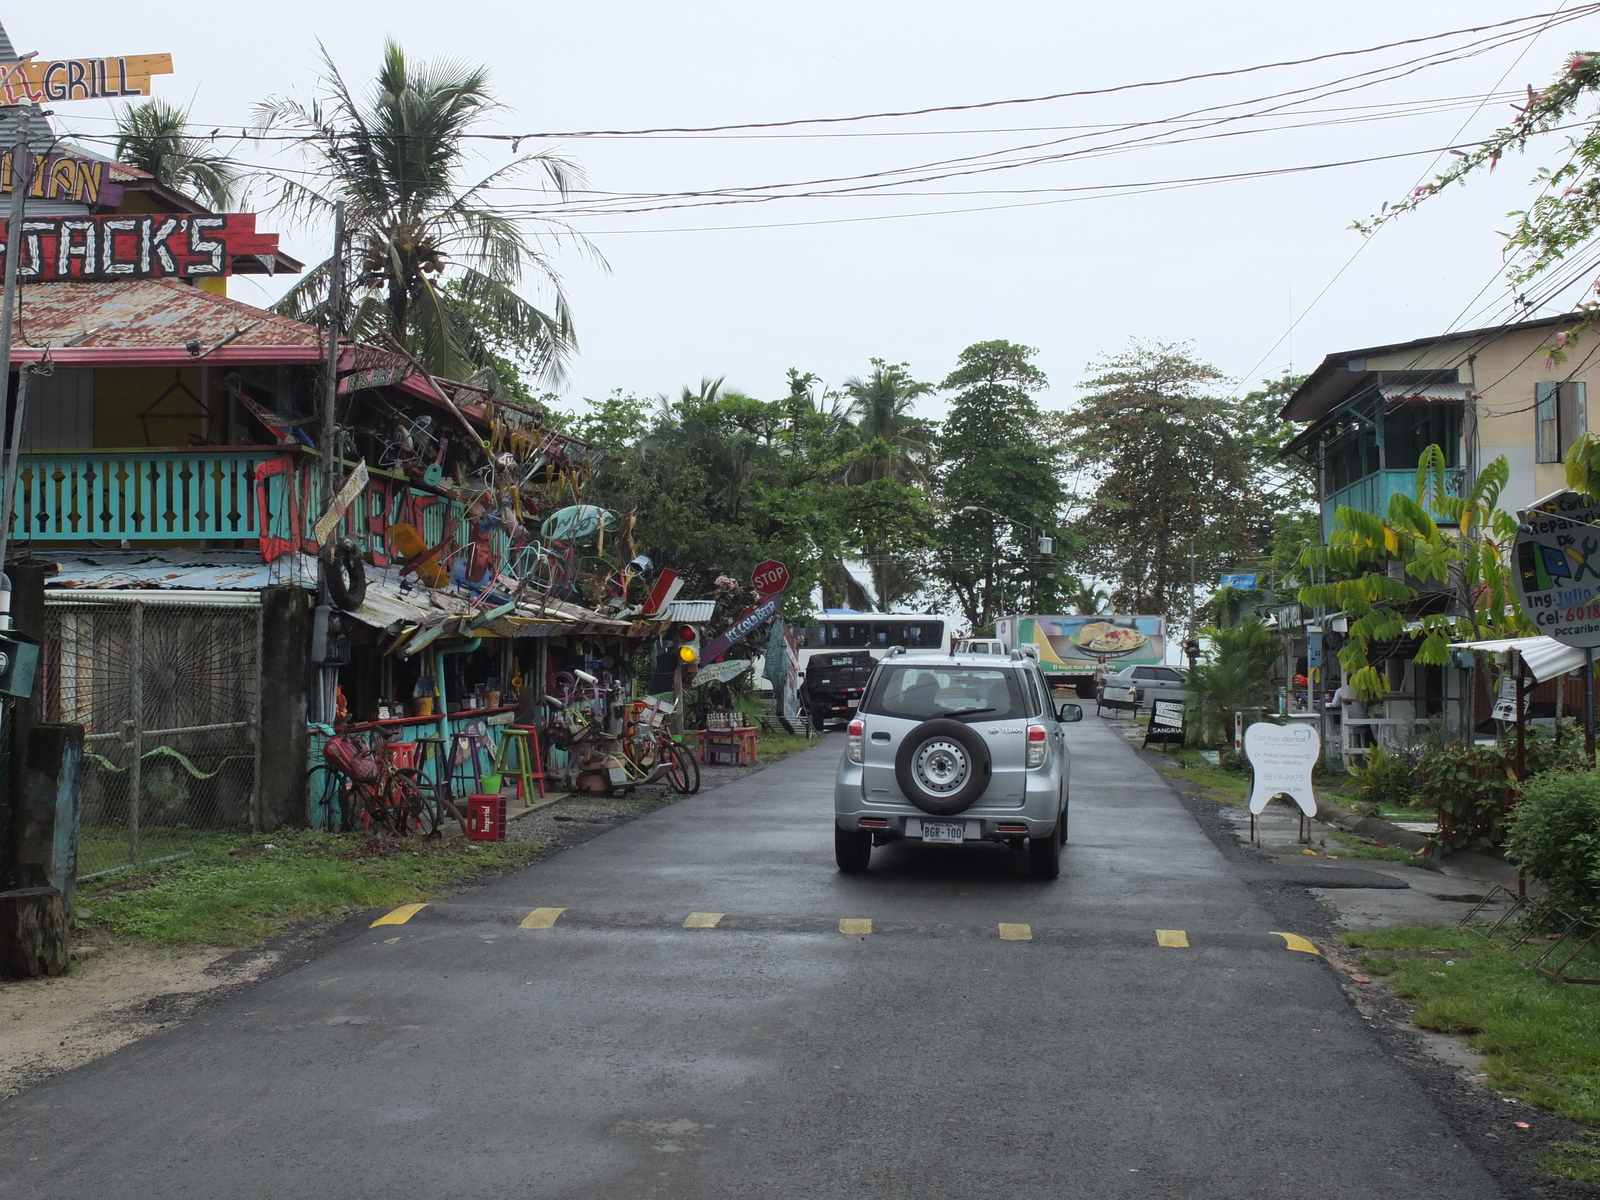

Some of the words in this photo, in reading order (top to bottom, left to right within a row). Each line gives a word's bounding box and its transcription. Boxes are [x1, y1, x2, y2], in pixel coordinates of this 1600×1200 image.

[43, 57, 142, 101] GRILL
[16, 216, 227, 277] JACK'S
[1527, 508, 1600, 536] Reparaci
[1556, 534, 1576, 547] DE
[754, 566, 784, 589] STOP
[1556, 588, 1591, 607] Julio
[725, 625, 740, 643] ICE
[739, 613, 758, 634] COLD
[755, 600, 776, 623] BEER
[1554, 623, 1600, 637] pccaribe
[1000, 727, 1024, 735] TERIOS
[1281, 735, 1307, 743] dental
[1263, 773, 1305, 782] 8819-9975
[480, 805, 494, 833] Imperial
